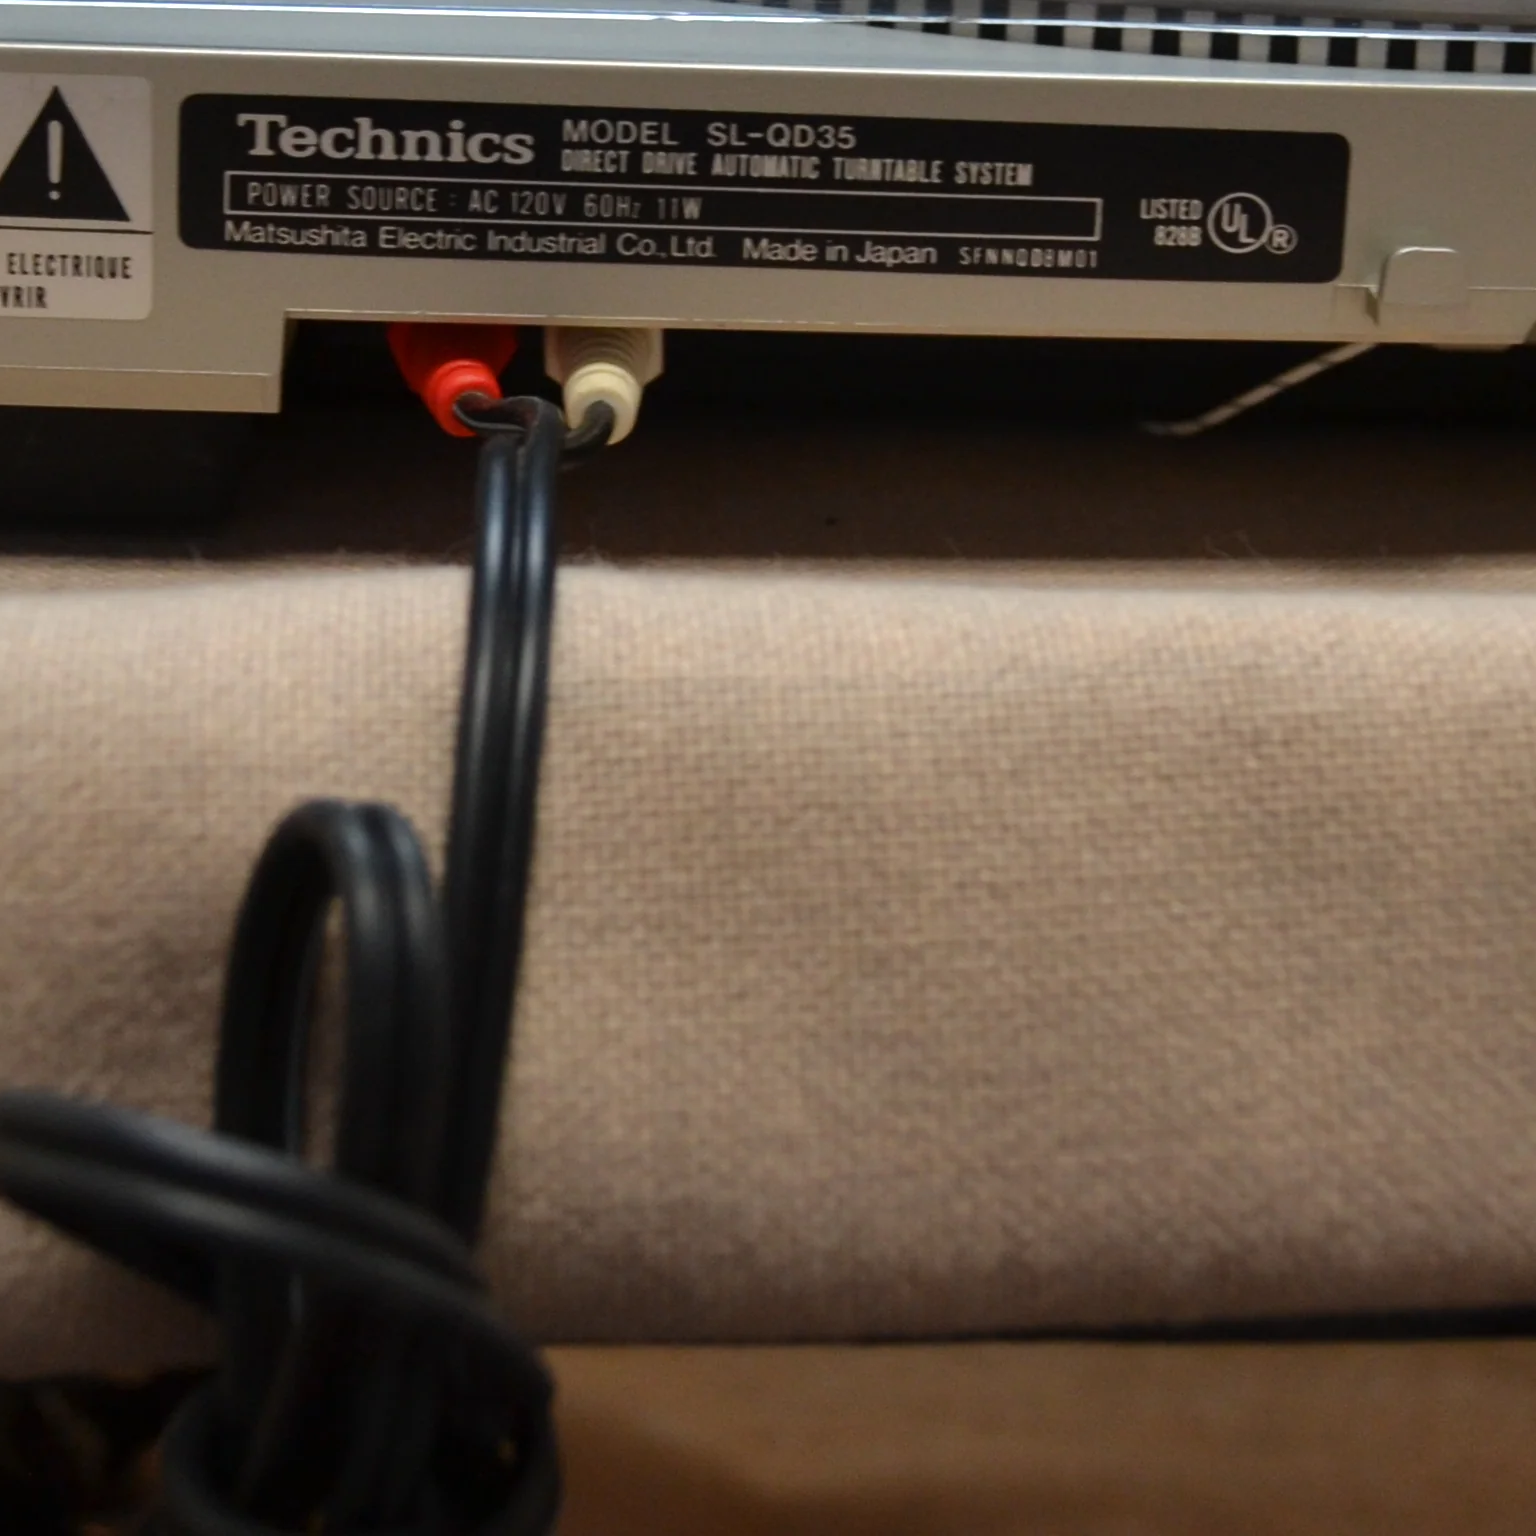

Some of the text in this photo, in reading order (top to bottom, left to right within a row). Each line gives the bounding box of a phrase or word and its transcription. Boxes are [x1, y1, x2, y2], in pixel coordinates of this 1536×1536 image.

[236, 112, 536, 166] Technics
[562, 118, 857, 150] MODEL SL-QD35
[561, 148, 1034, 186] DIRECT DRIVE AUTOMATIC TURNTABLE SYSTEM
[247, 181, 331, 208] POWER
[346, 185, 439, 213] SOURCE
[468, 190, 500, 215] AC
[510, 192, 566, 217] 120V
[583, 194, 642, 220] 60Hz
[657, 195, 704, 221] 11W
[1140, 198, 1204, 220] LISTED
[1220, 202, 1259, 245] UL
[224, 220, 368, 248] Matsushita
[378, 226, 477, 252] Electric
[486, 229, 606, 256] Industrial
[743, 237, 818, 263] Made
[826, 239, 848, 263] in
[856, 241, 938, 267] Japan
[6, 251, 134, 280] ELECTRIQUE
